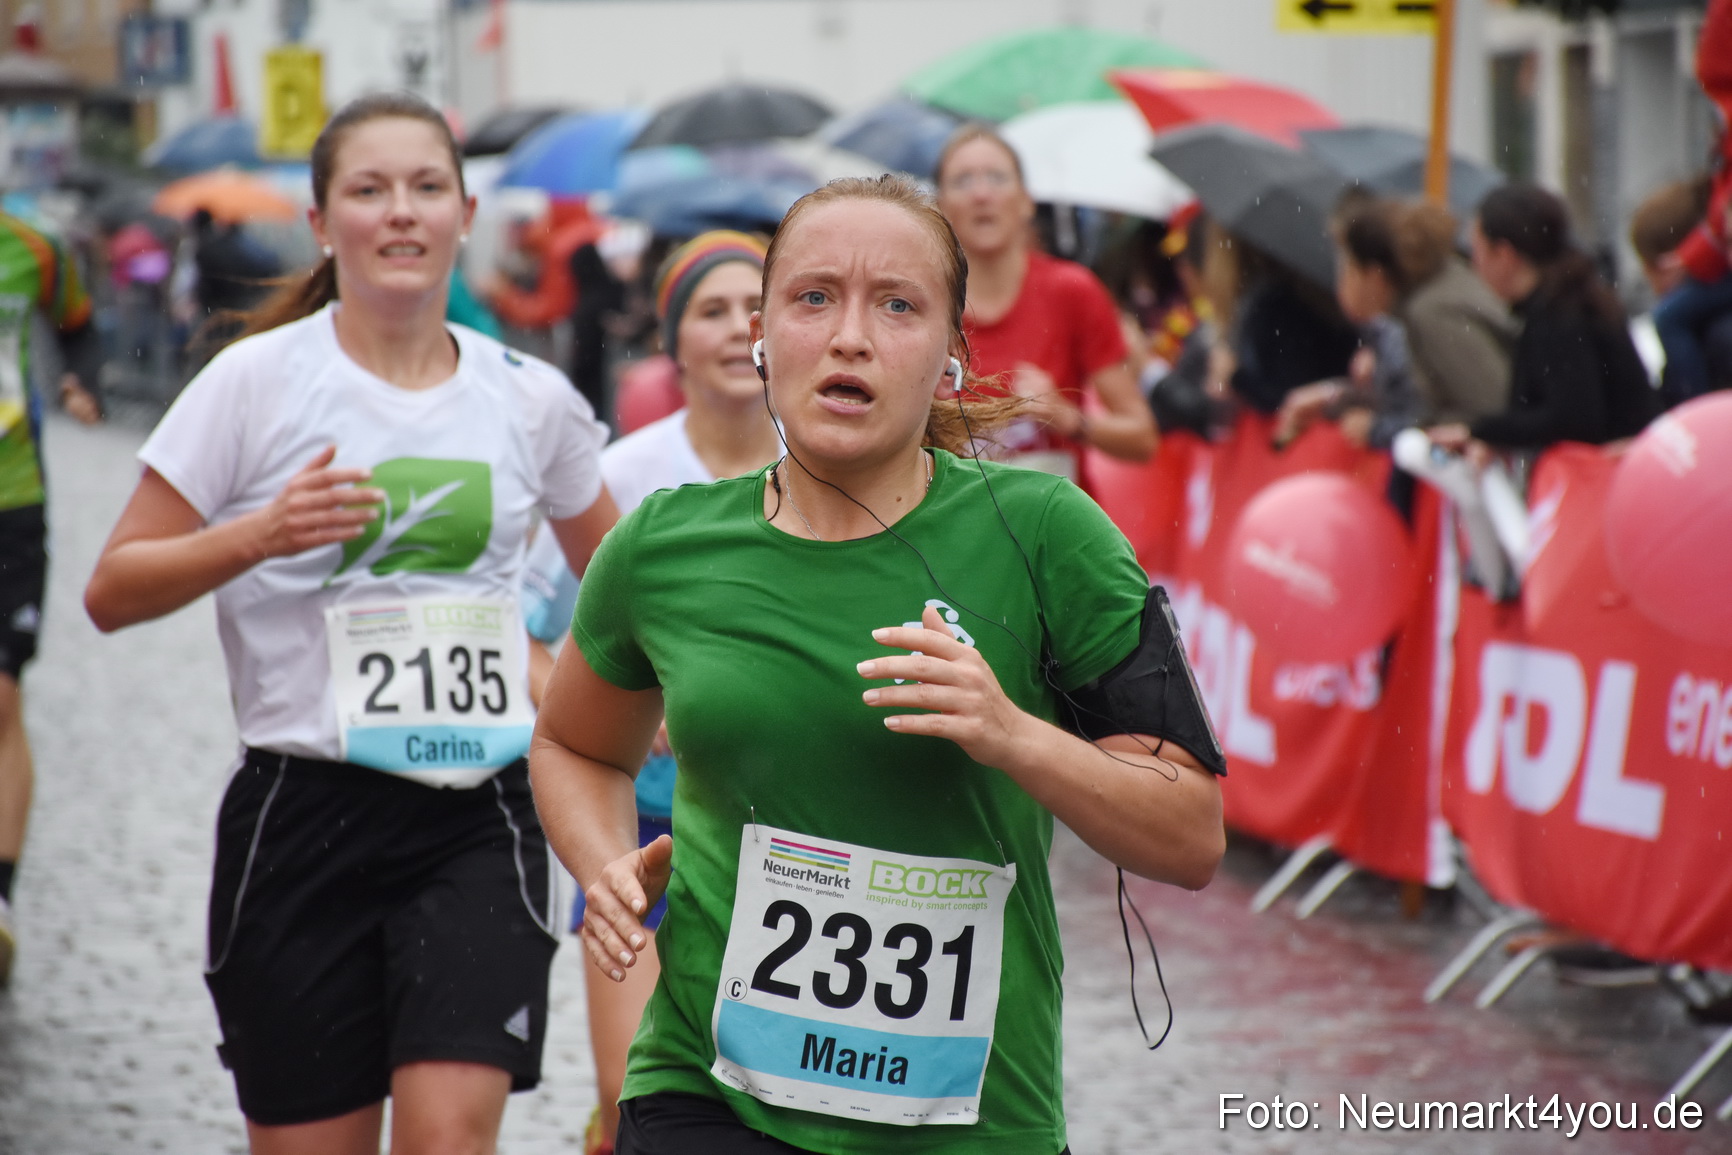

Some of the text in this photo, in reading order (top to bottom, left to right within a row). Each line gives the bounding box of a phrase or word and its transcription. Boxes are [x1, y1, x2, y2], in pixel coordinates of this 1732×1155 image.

[358, 646, 508, 716] 2135
[405, 735, 485, 763] Carina
[763, 858, 851, 890] NeuerMarkt
[765, 877, 845, 900] einkaufen leben genießen
[868, 860, 994, 899] BOCK
[866, 892, 988, 912] inspired by smart concepts
[750, 899, 976, 1021] 2331
[800, 1032, 909, 1086] Maria
